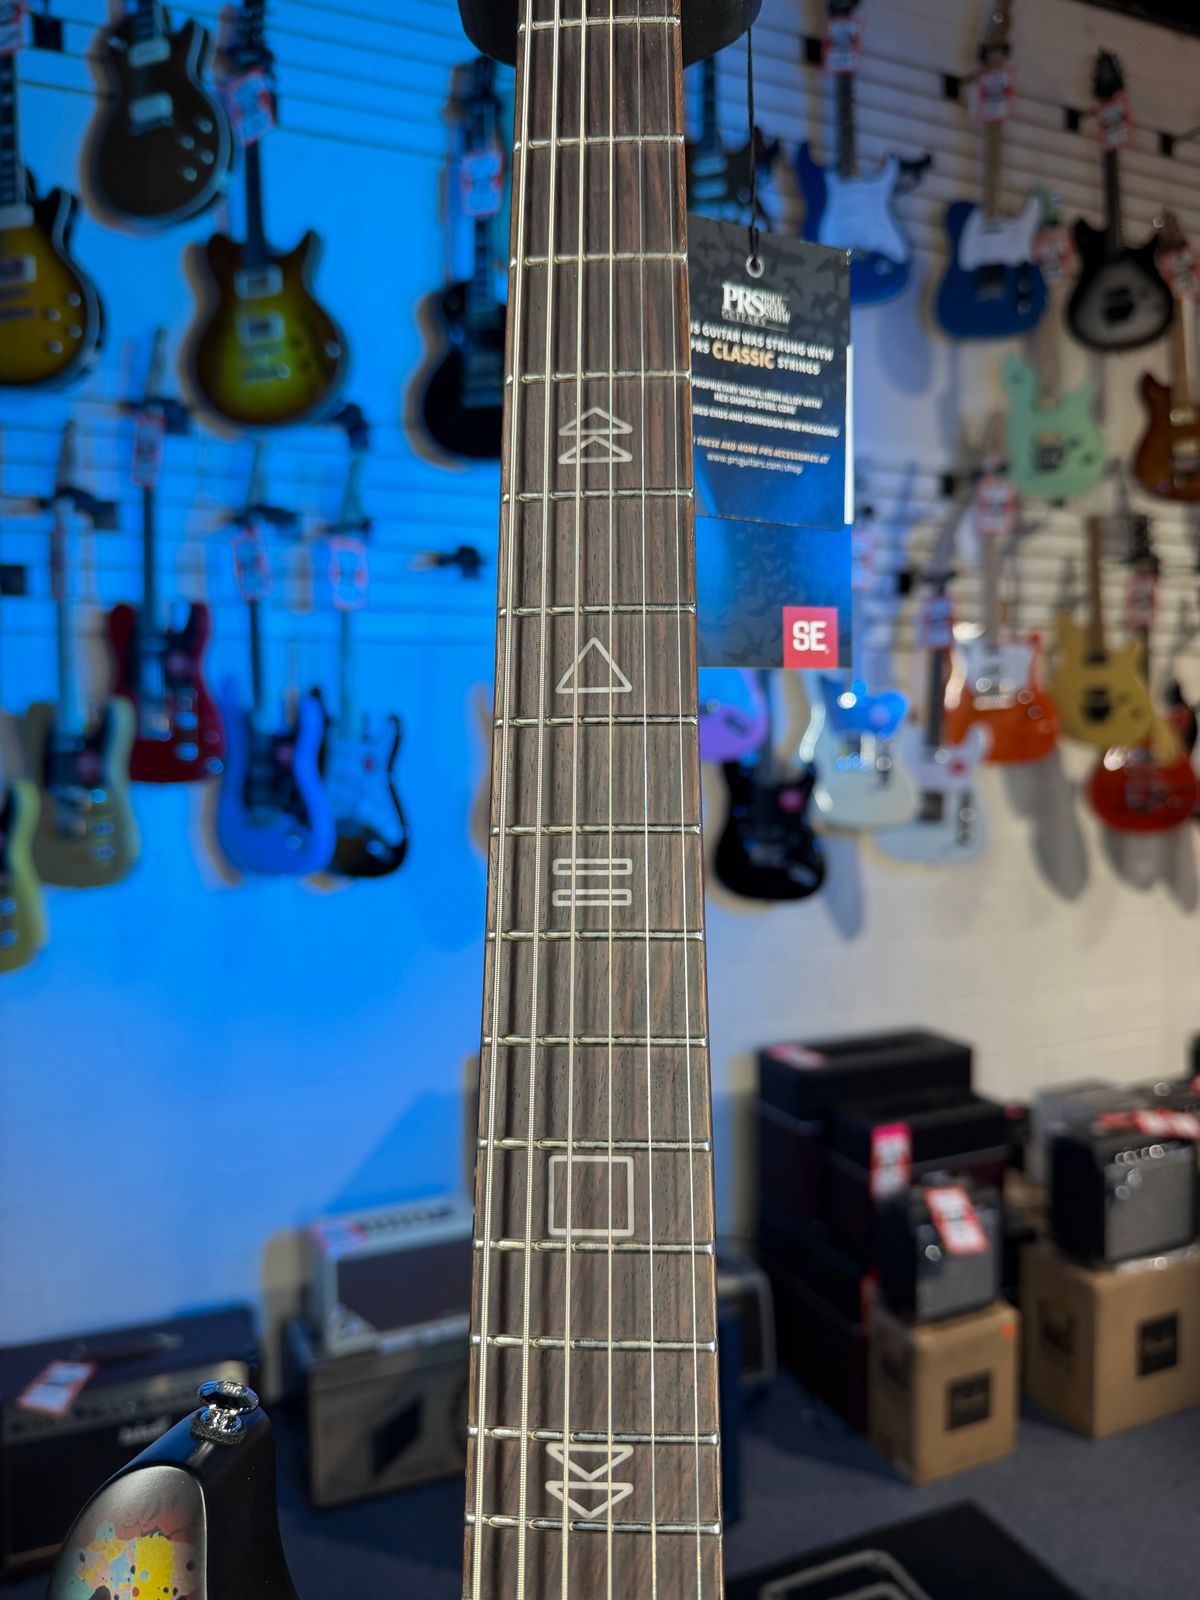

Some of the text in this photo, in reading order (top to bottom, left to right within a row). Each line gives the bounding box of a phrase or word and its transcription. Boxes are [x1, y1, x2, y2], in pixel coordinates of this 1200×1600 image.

[722, 283, 767, 317] PRS
[690, 337, 821, 375] PRS CLASSIC STRINGS
[702, 321, 741, 344] GUITAR
[741, 329, 765, 348] WAS
[765, 334, 806, 356] STRUNG
[806, 343, 834, 361] WITH
[792, 620, 828, 652] SE
